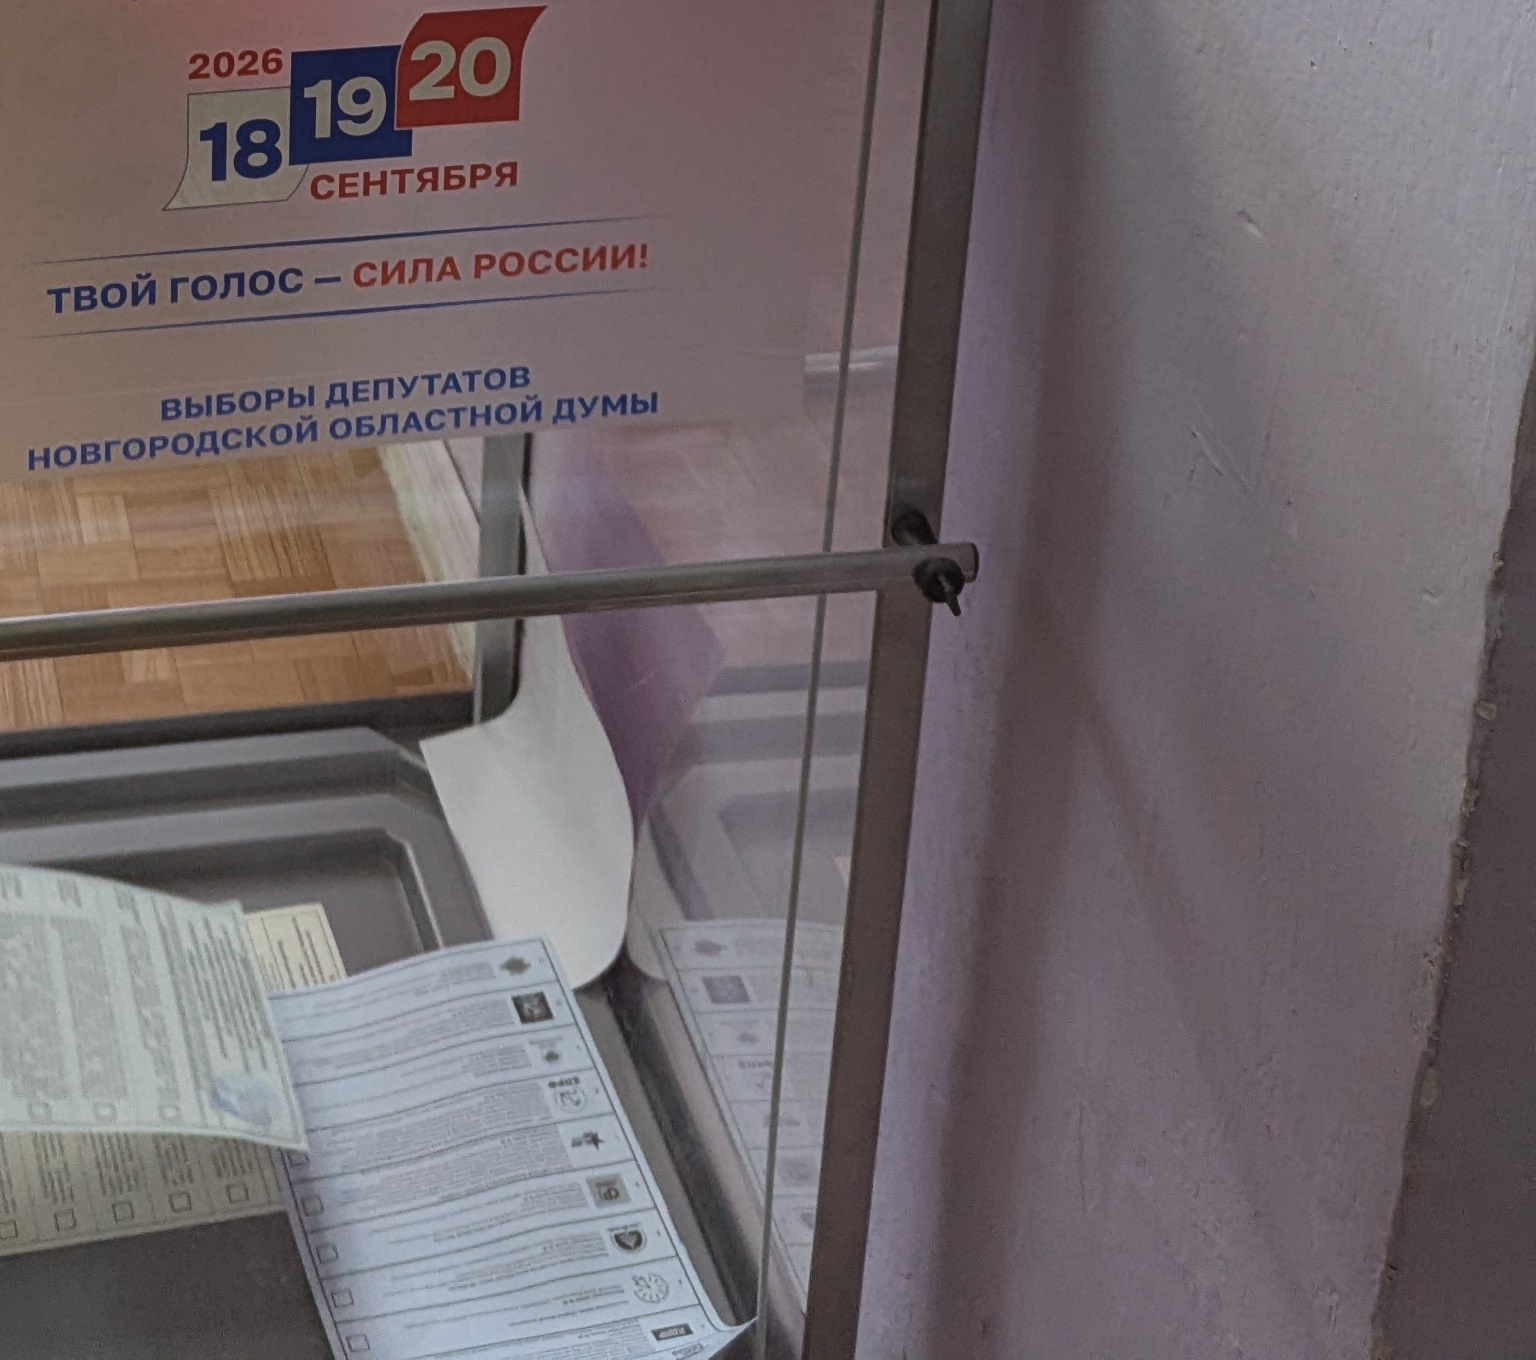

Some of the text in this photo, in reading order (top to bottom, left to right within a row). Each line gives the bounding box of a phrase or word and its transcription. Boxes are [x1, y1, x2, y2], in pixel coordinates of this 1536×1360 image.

[188, 47, 283, 80] 2026
[409, 36, 512, 100] 20
[302, 76, 387, 139] 19
[198, 118, 283, 182] 18
[309, 160, 519, 200] СЕНТЯБРЯ
[46, 272, 157, 314] ТВОЙ
[169, 266, 304, 305] ГОЛОС
[352, 255, 462, 288] СИЛА
[474, 242, 649, 280] РОССИИ!
[160, 366, 532, 422] ВЫБОРЫ ДЕПУТАТОВ
[27, 391, 659, 471] НОВГОРОДСКОЙ ОБЛАСТНОЙ ДУМЫ
